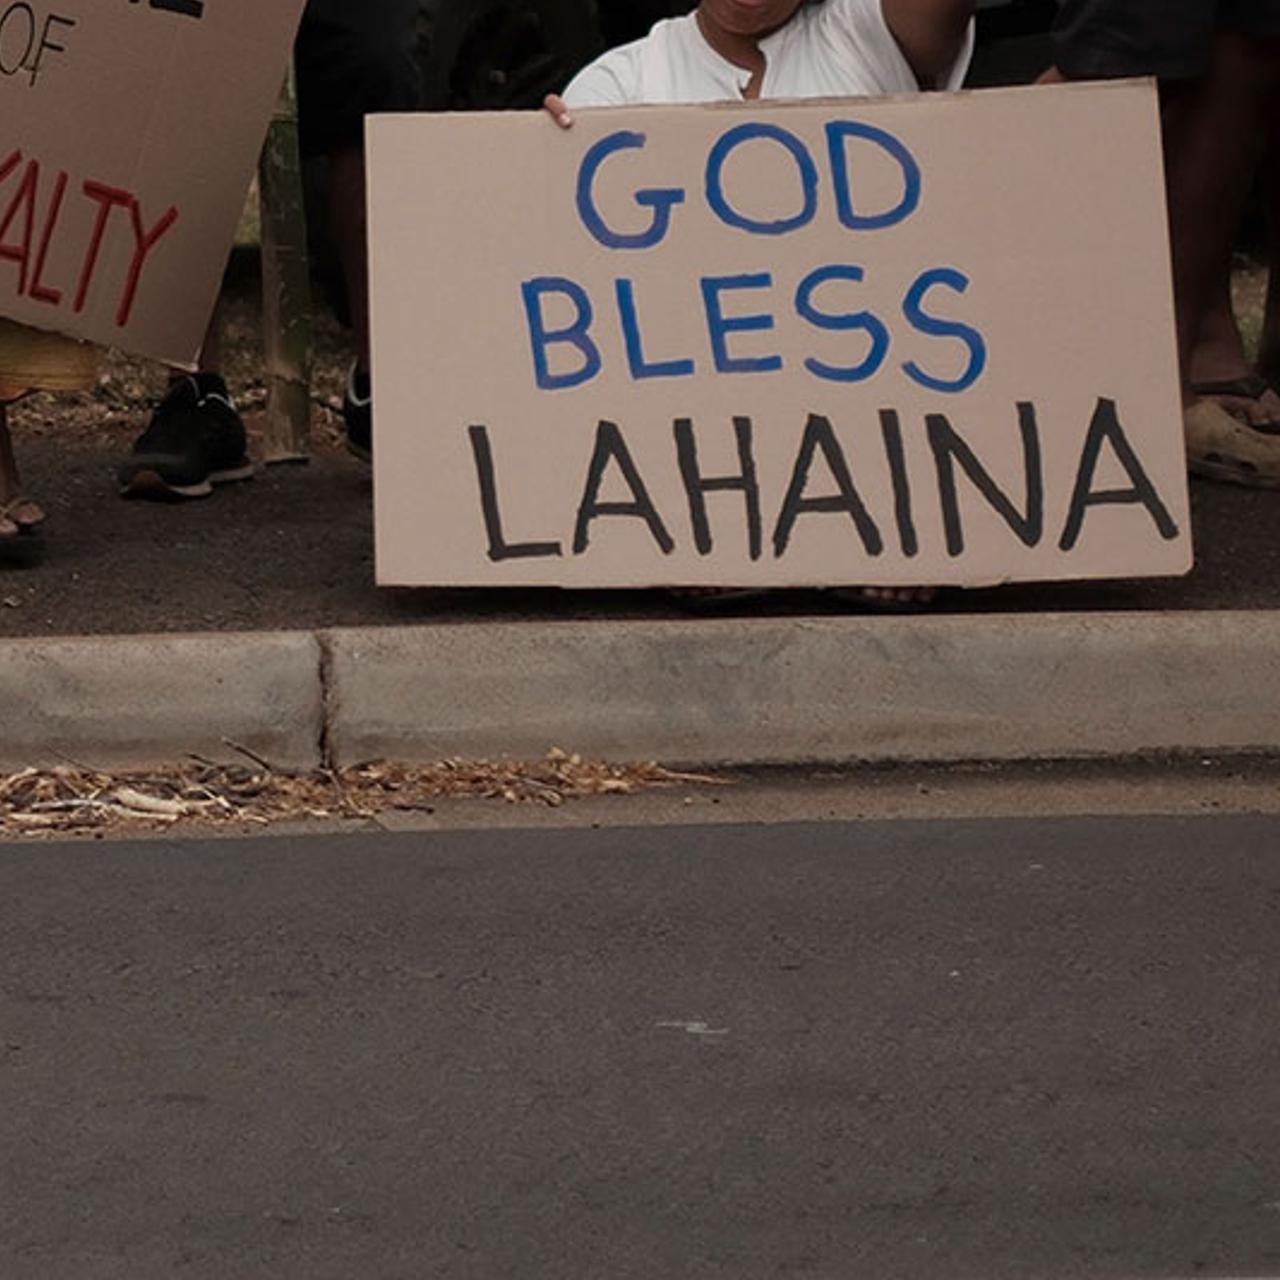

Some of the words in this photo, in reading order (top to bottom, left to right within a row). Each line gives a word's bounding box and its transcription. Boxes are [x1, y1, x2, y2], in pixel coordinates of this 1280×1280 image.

[574, 120, 923, 250] GOD
[519, 264, 988, 394] BLESS
[467, 396, 1180, 562] LAHAINA
